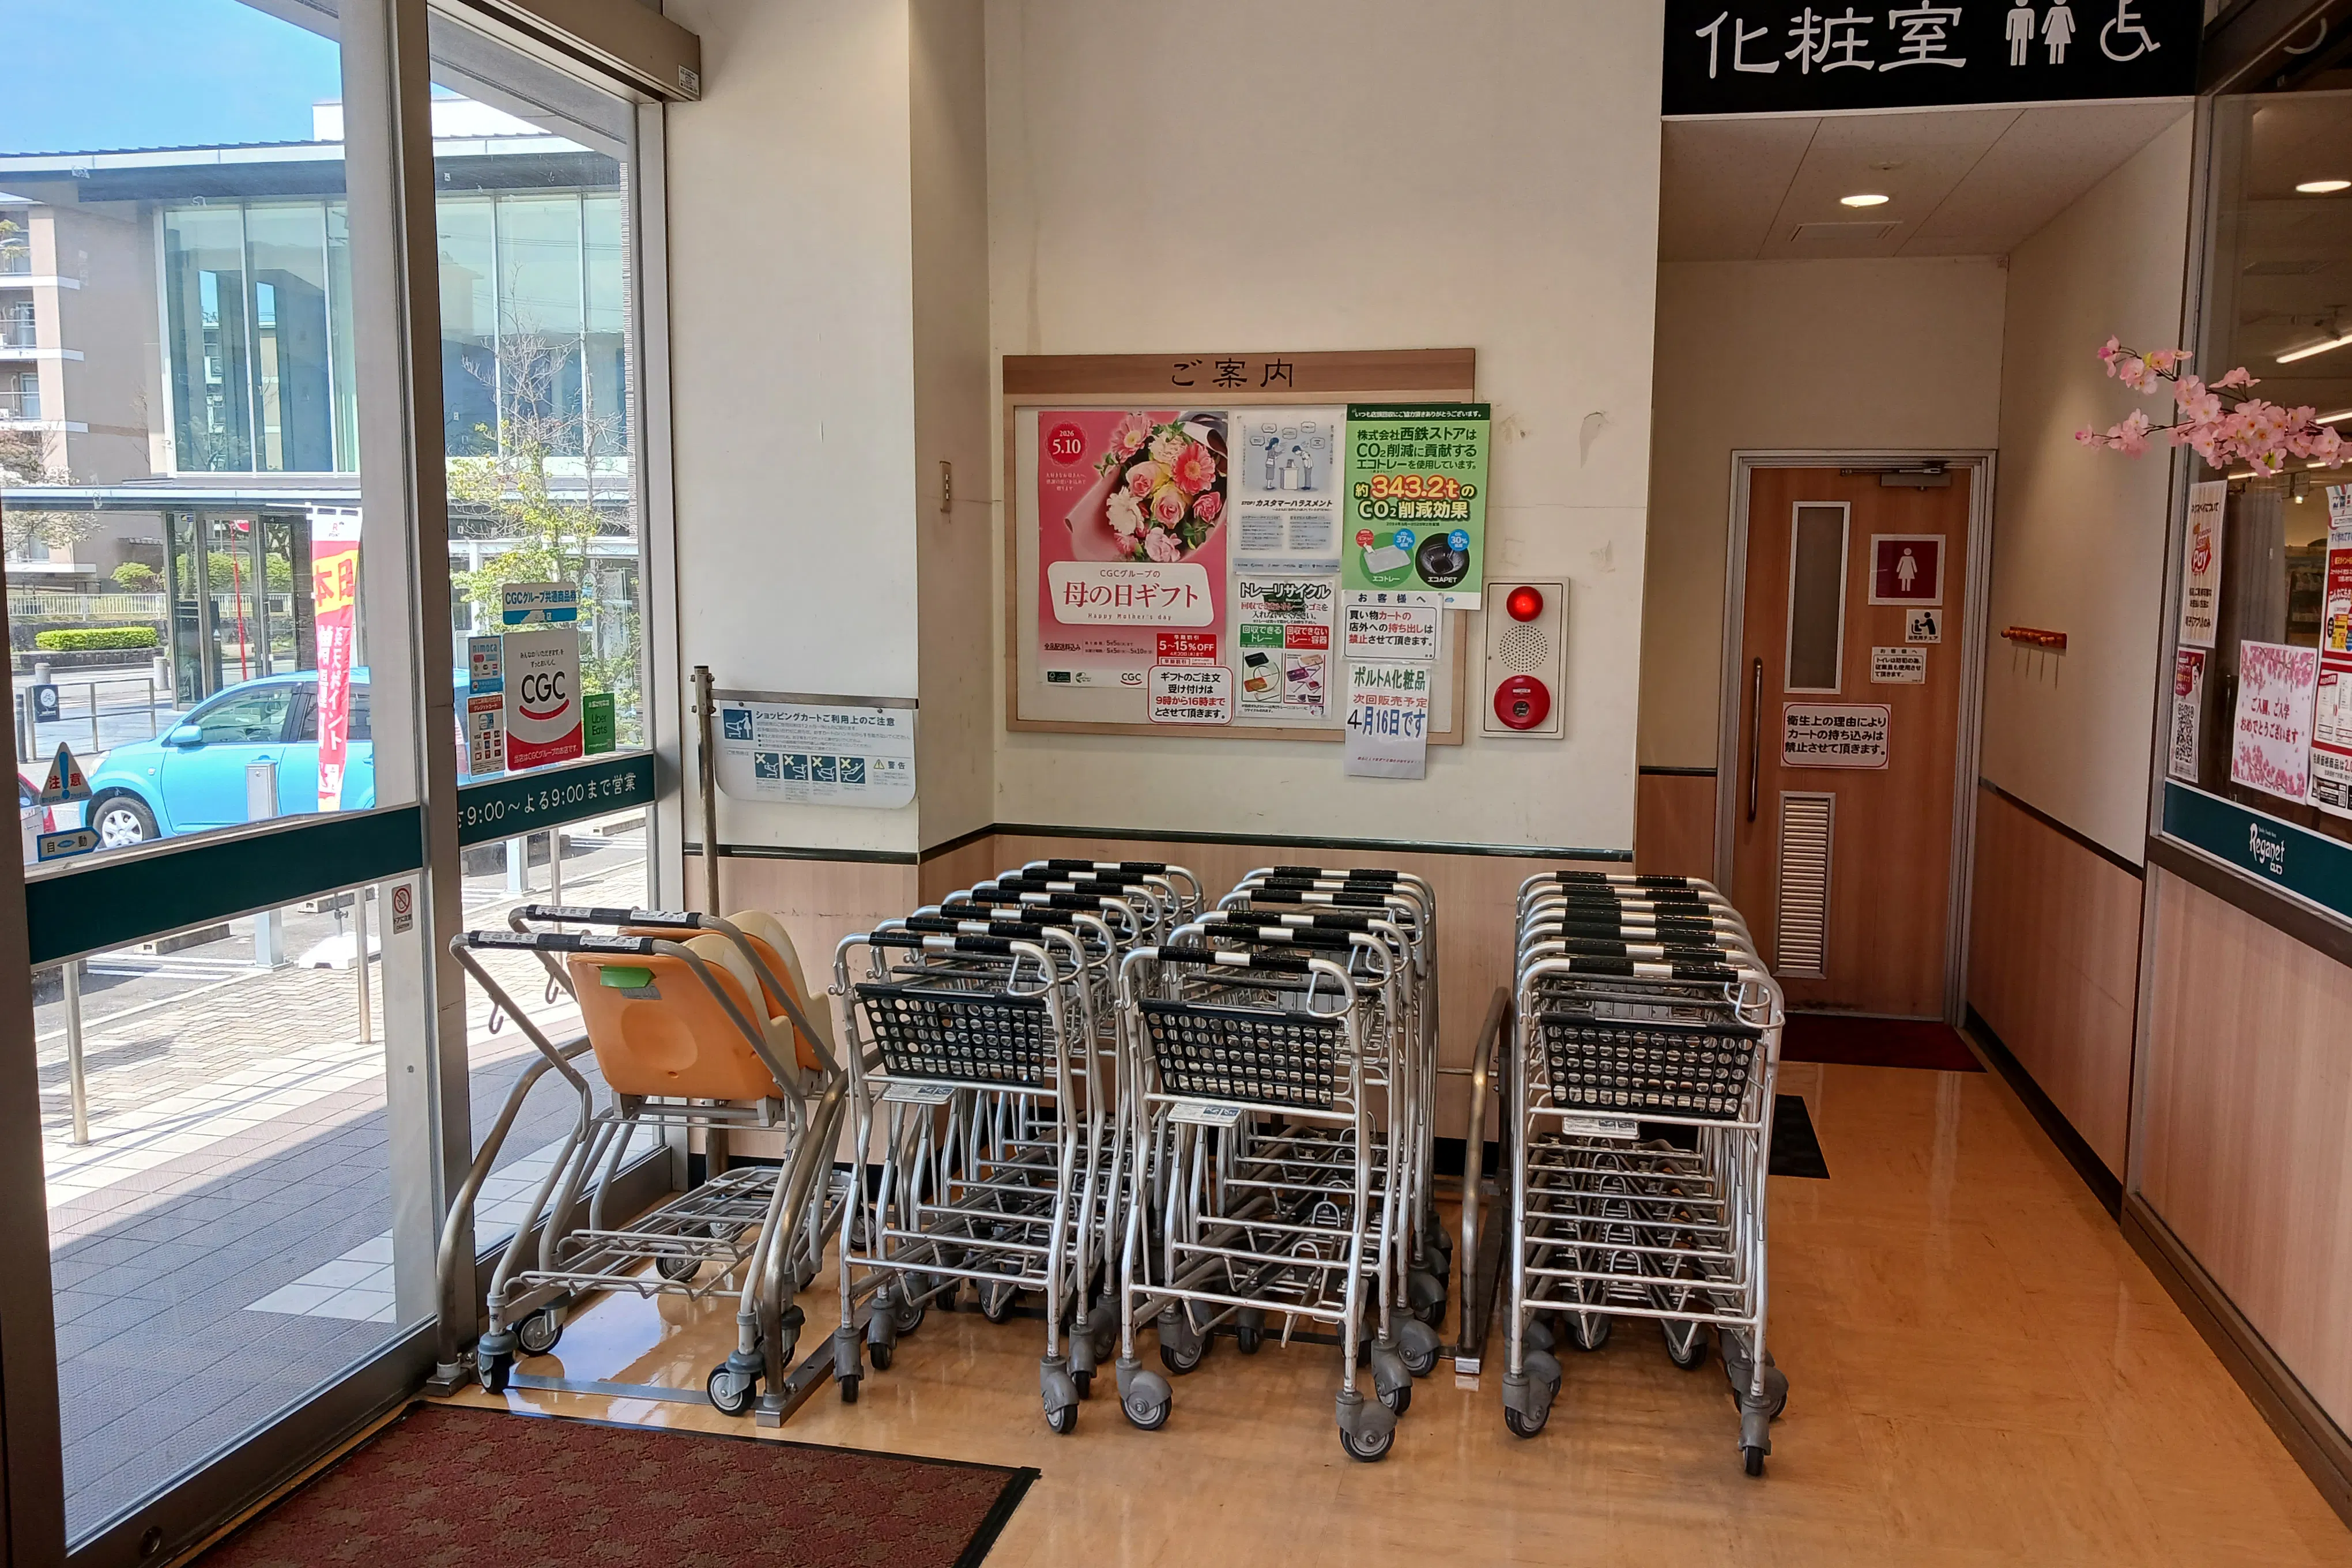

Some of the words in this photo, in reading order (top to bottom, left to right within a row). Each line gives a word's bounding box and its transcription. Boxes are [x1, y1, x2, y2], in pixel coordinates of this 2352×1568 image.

[1696, 0, 1966, 78] 化粧室
[1172, 357, 1293, 388] ご案内
[1357, 427, 1477, 441] 株式会社西鉄ストアは
[1053, 439, 1081, 454] 5.10
[1356, 459, 1476, 470] エコトレーを使用しています。
[1451, 536, 1468, 544] 30%
[1100, 570, 1160, 578] CGCグループの
[1063, 581, 1198, 608] 母の日ギフト
[1240, 582, 1331, 600] トレーリサイクル
[1350, 610, 1411, 620] 買い物カートの
[1242, 625, 1281, 634] 回収できる
[1287, 627, 1328, 635] 回収できない
[1349, 622, 1434, 634] 店外への持ち出しは
[1252, 634, 1273, 642] トレー
[1348, 634, 1433, 646] 禁止させて頂きます。
[473, 643, 497, 653] nimoca
[1160, 673, 1221, 683] ギフトのご注文
[1354, 666, 1426, 691] ポルトA化粧品
[521, 671, 566, 703] CGC
[1168, 684, 1213, 694] 受け付けは
[1156, 696, 1226, 706] 9時から16時まで
[1353, 693, 1427, 708] 次回販売予定
[591, 714, 607, 723] Uber
[756, 711, 895, 726] ショッピングカートご利用上のご注意
[1155, 708, 1225, 719] とさせて頂きます。
[1347, 706, 1426, 738] 4月16日です
[1786, 715, 1886, 728] 衛生上の理由により
[592, 725, 607, 736] Eats
[1788, 729, 1884, 741] カートの持ち込みは
[2240, 717, 2298, 744] おめでとうございます
[1785, 742, 1886, 755] 禁止させて頂きます。
[48, 772, 81, 790] 注意
[47, 835, 87, 853] 自動
[2249, 823, 2285, 864] Reganet
